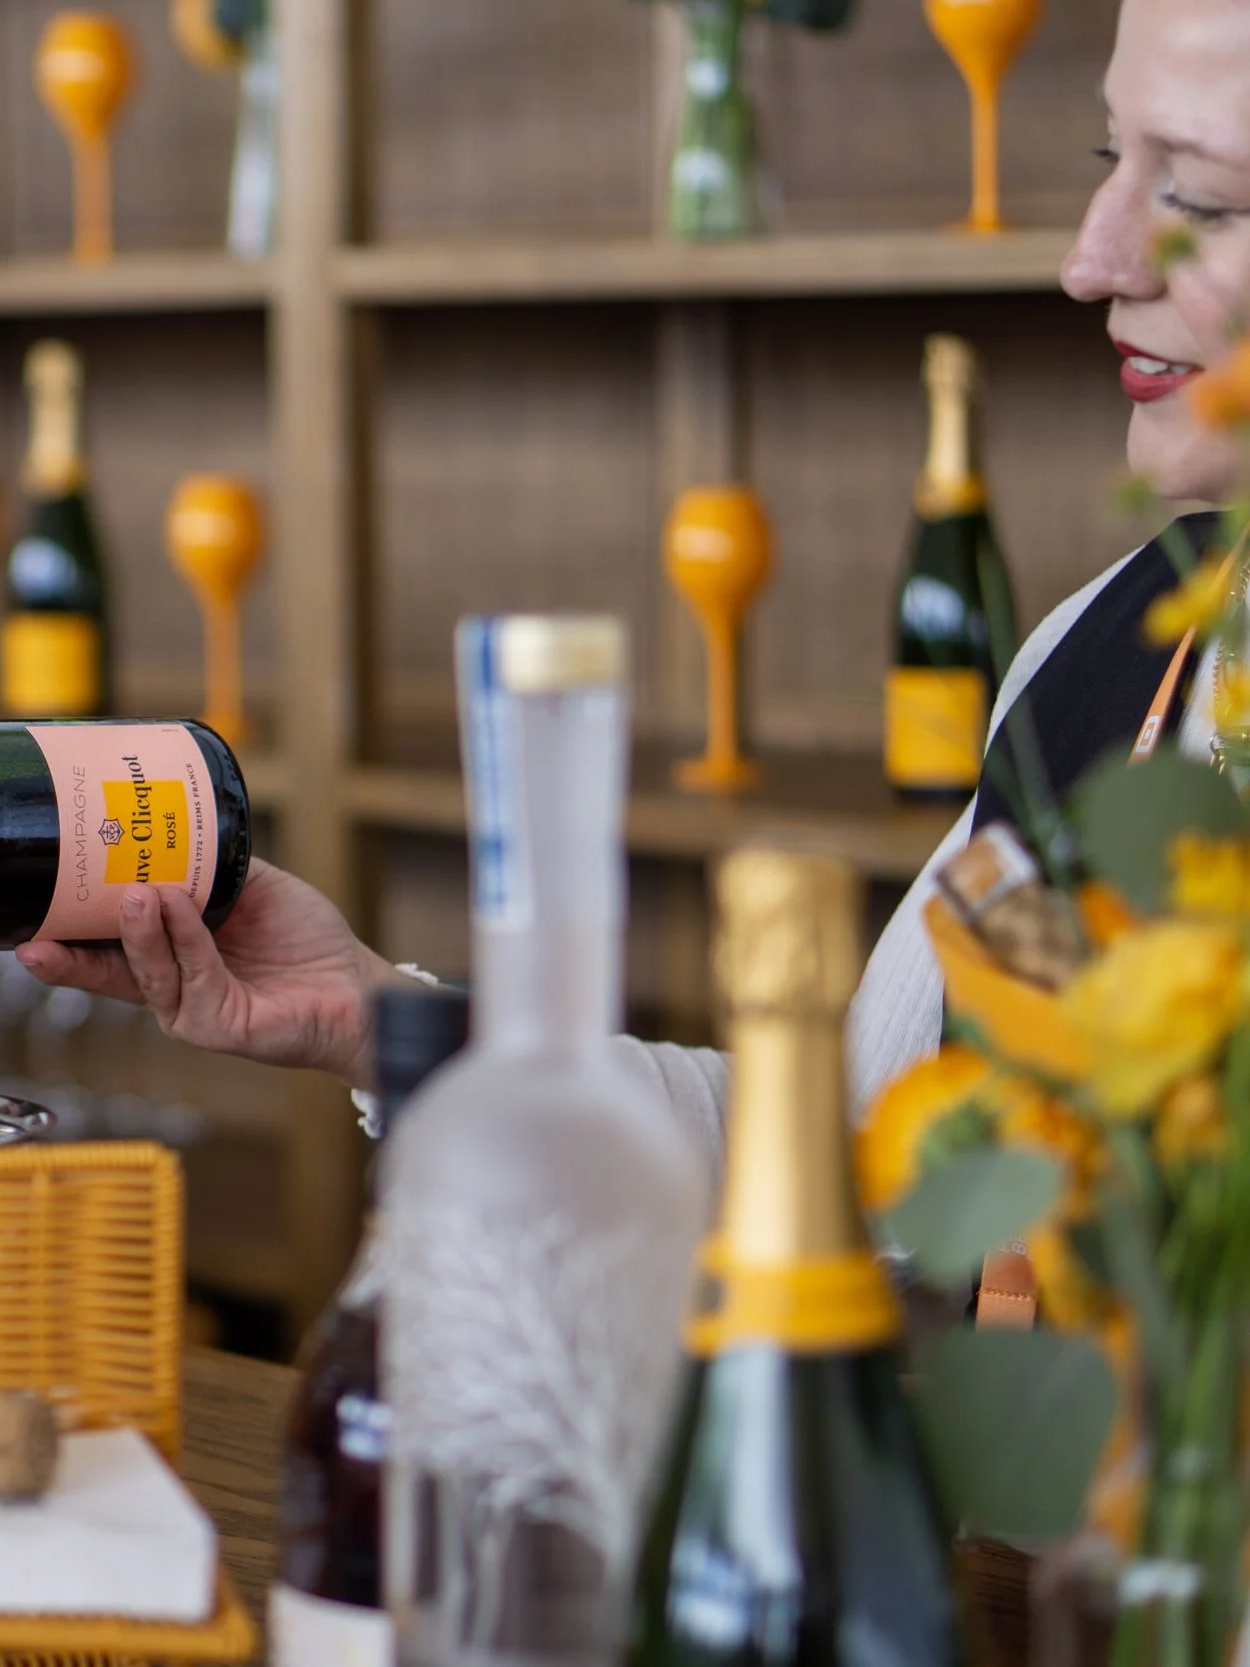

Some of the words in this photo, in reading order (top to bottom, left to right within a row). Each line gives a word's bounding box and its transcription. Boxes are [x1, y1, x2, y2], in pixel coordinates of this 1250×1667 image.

[121, 754, 153, 842] Clicquot
[185, 763, 200, 798] FRANCE
[72, 764, 90, 902] CHAMPAGNE
[162, 811, 176, 849] ROSÉ
[134, 848, 153, 884] uve
[189, 864, 202, 898] DEPUIS
